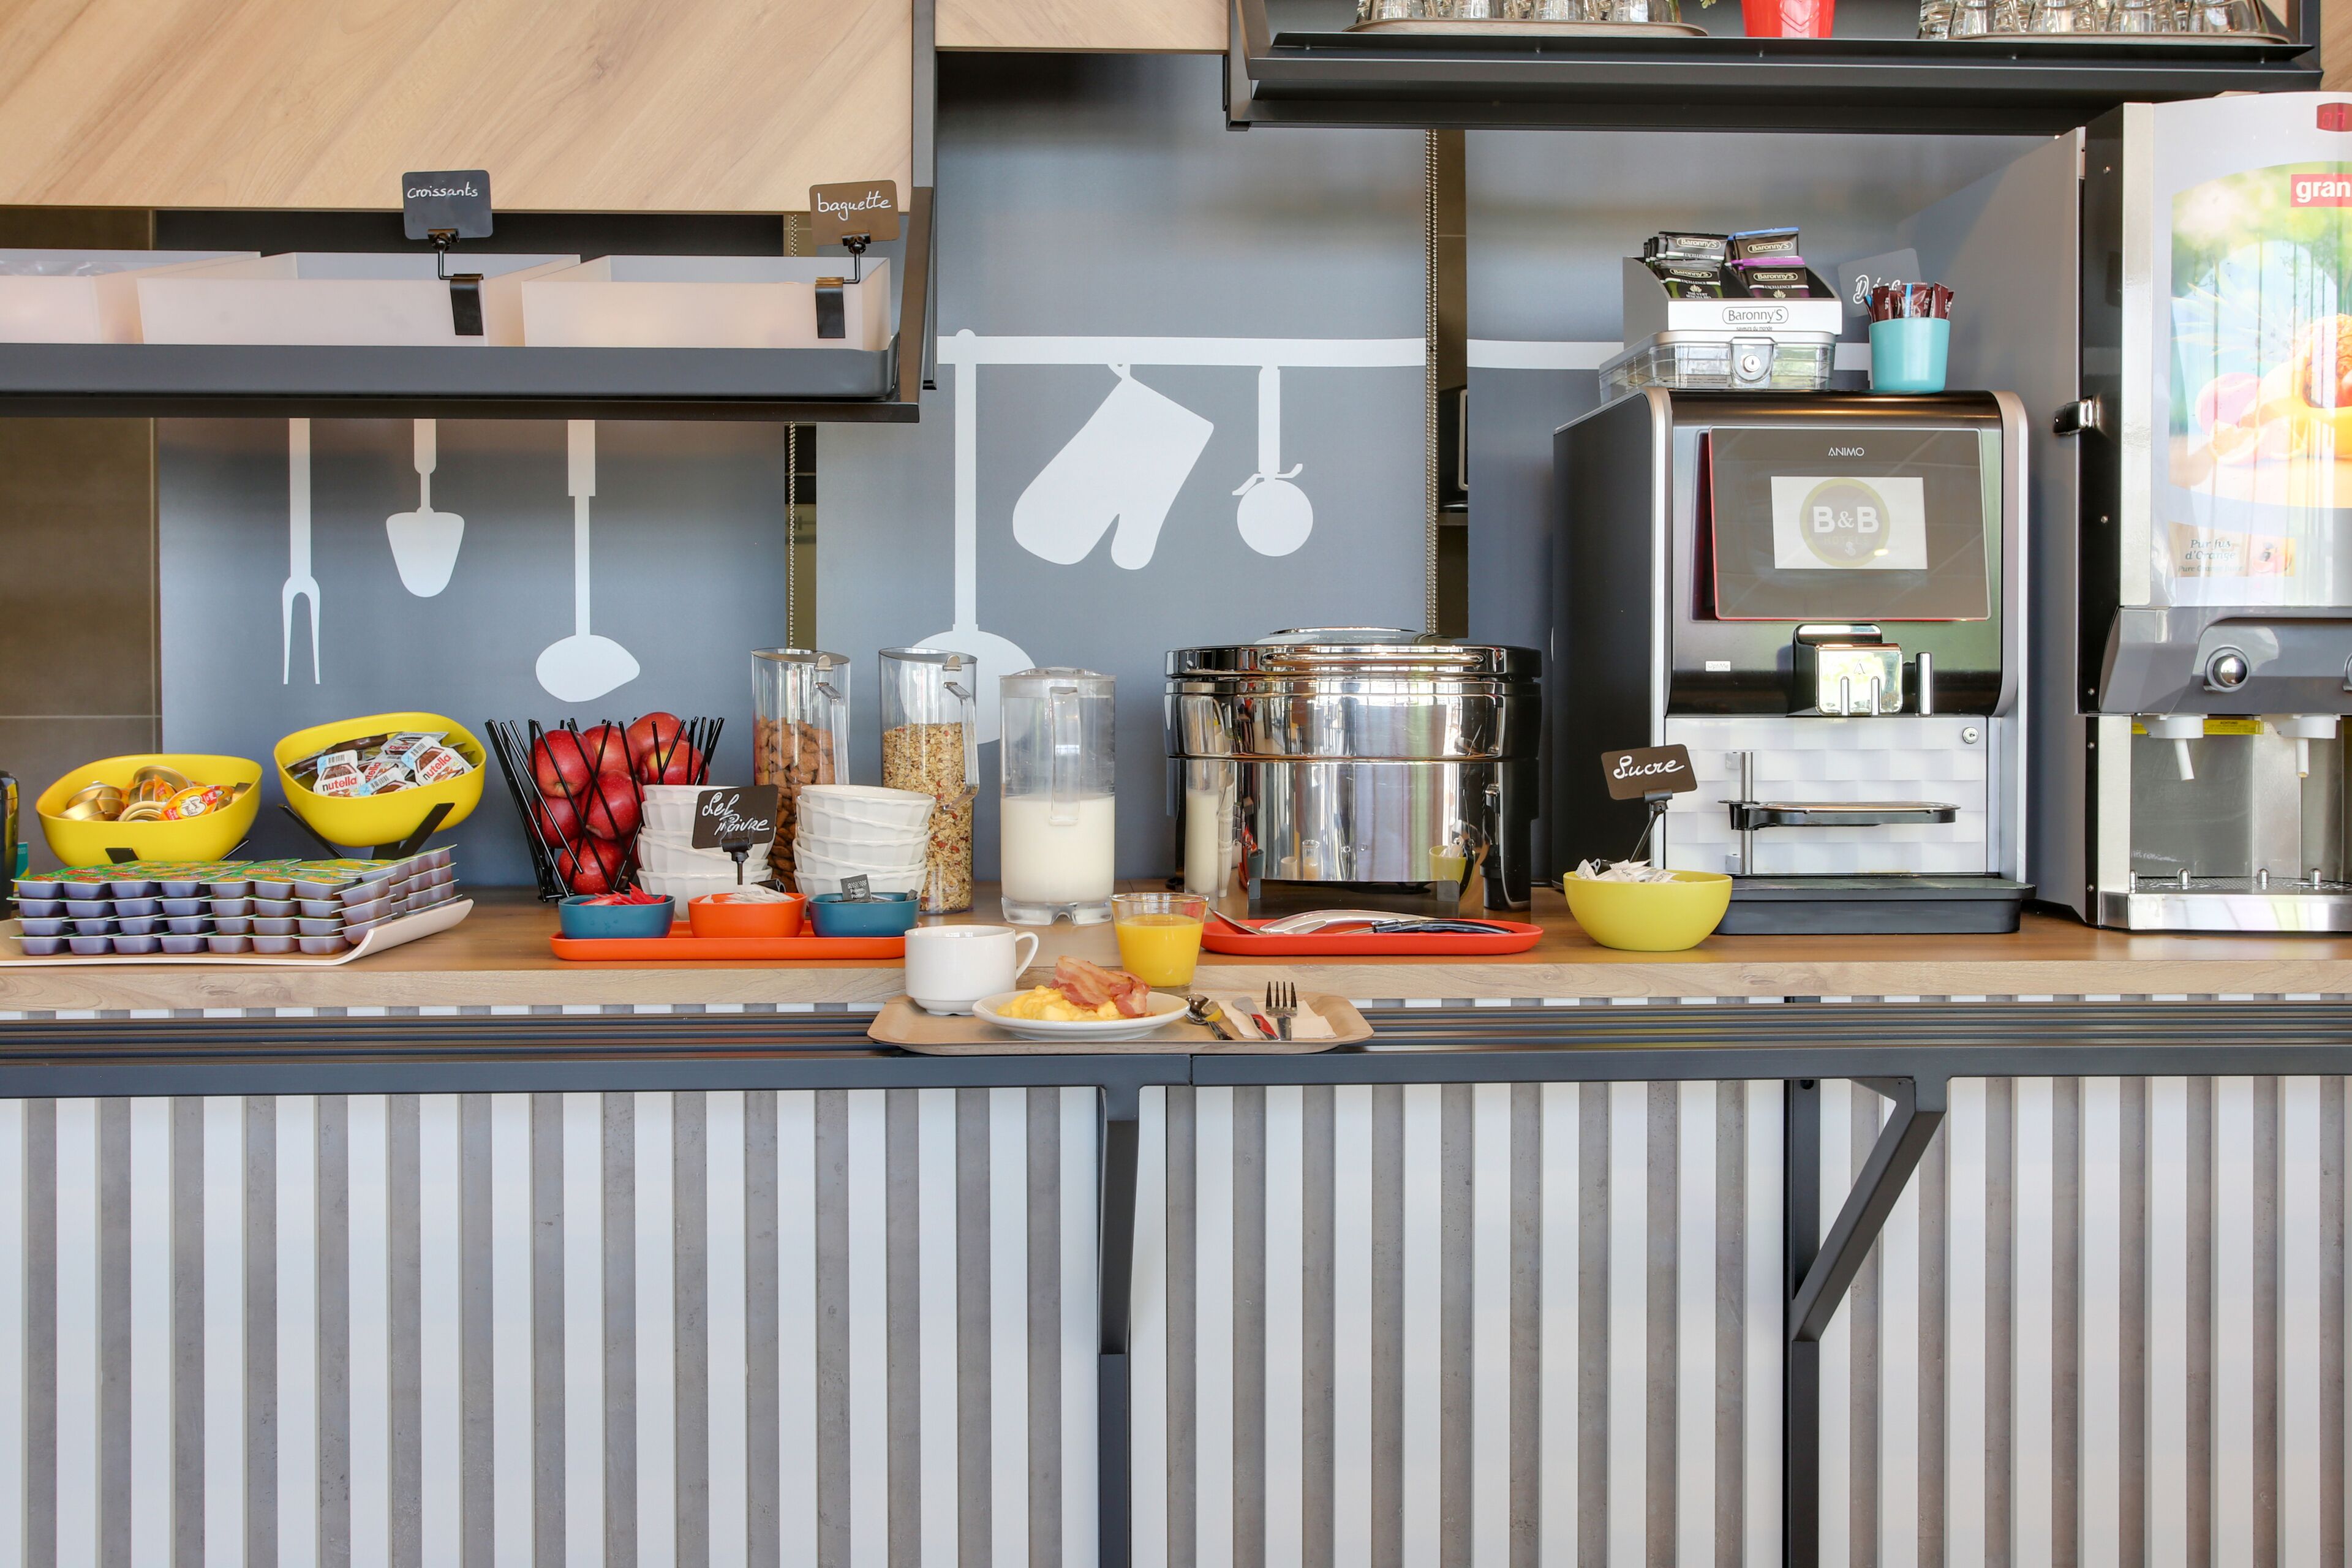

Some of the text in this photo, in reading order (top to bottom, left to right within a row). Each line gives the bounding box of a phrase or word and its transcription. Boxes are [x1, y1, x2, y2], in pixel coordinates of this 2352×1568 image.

[407, 181, 478, 198] croissants
[2296, 181, 2352, 203] gran
[817, 190, 892, 221] baguette
[1828, 447, 1864, 456] ANIMO
[1813, 506, 1879, 533] B&B
[365, 762, 382, 782] utella
[423, 754, 452, 781] nutella
[1613, 755, 1684, 779] Sucre
[322, 776, 358, 791] nutella
